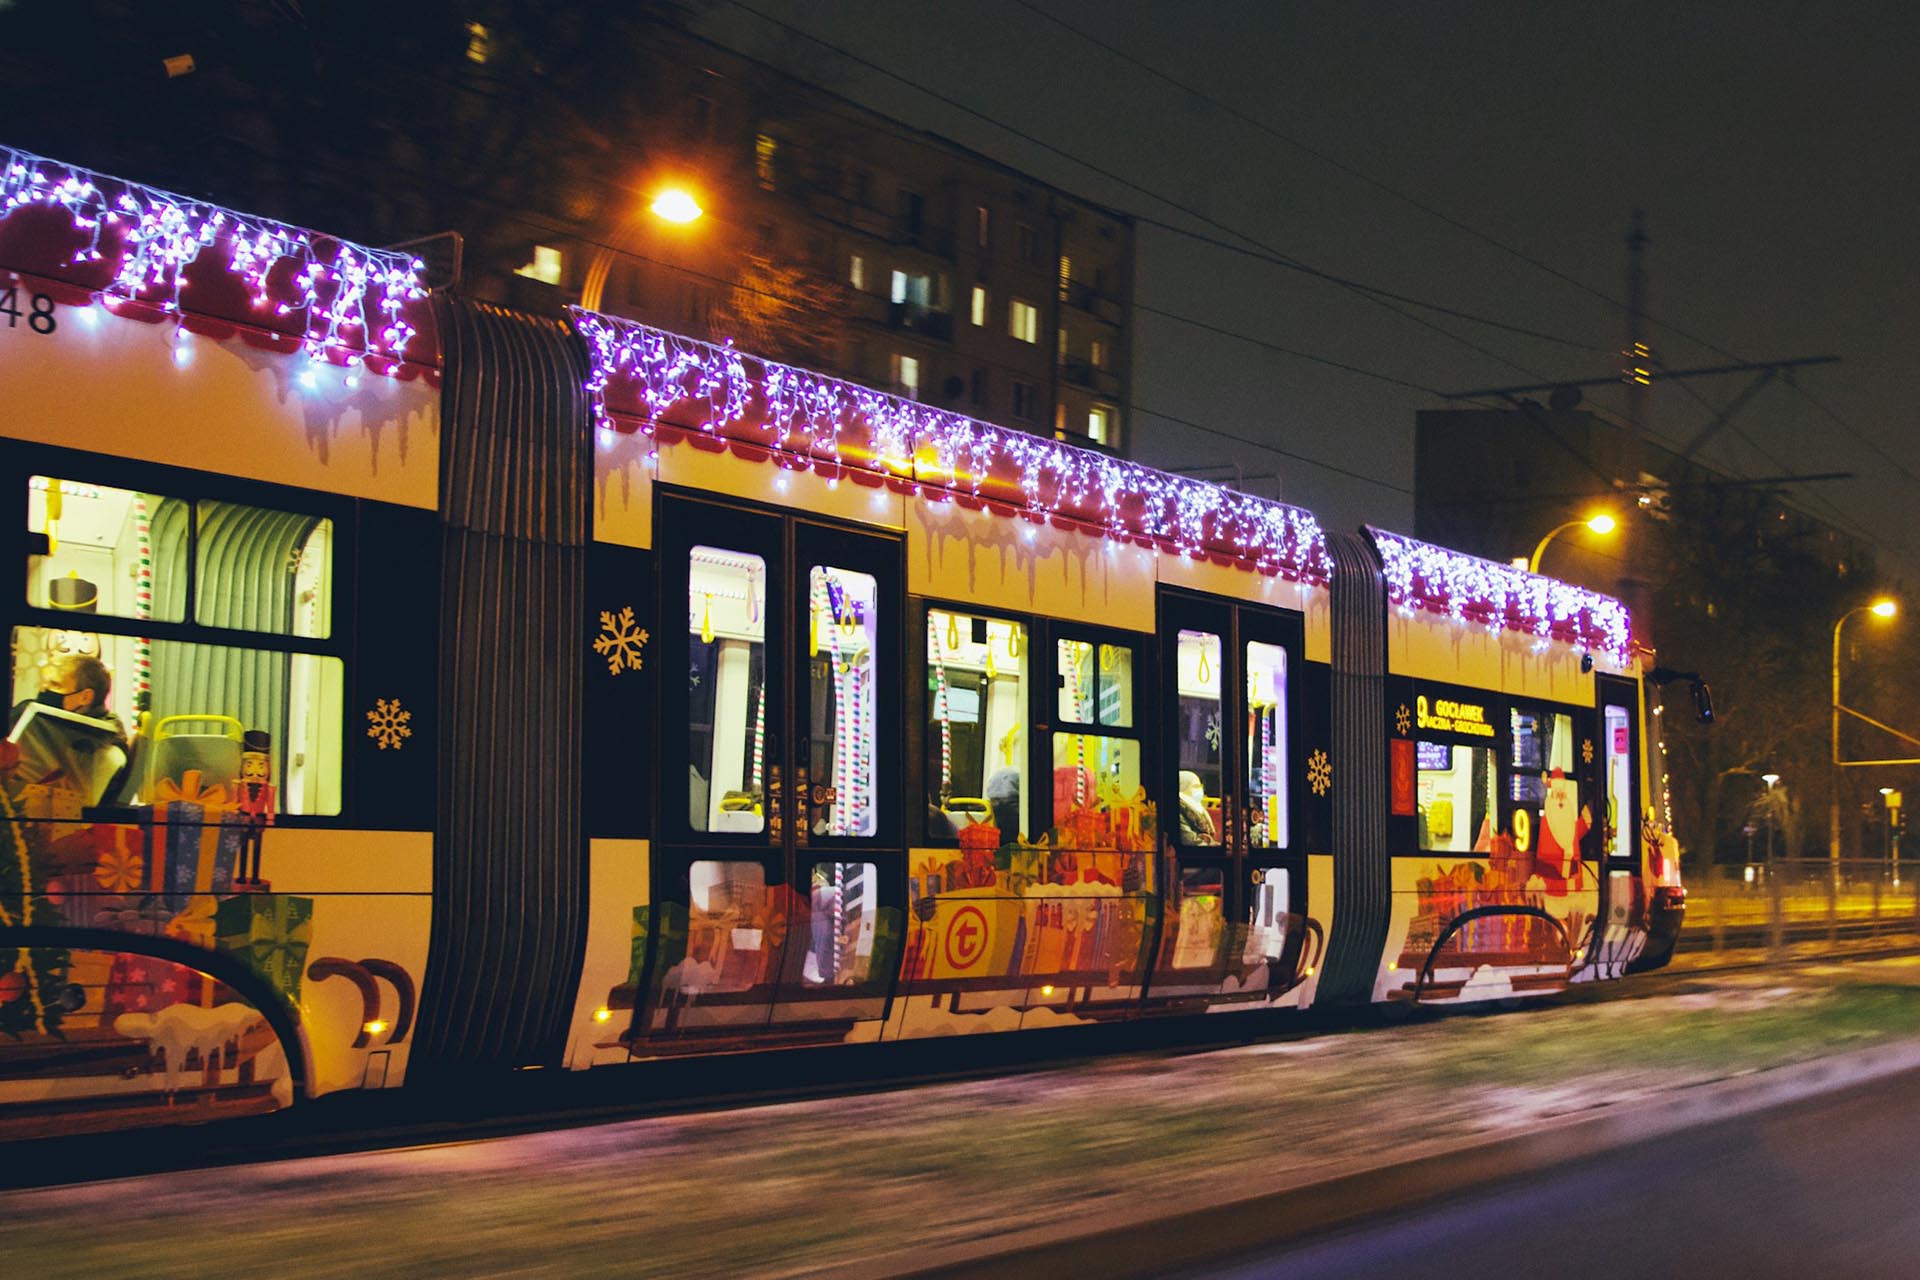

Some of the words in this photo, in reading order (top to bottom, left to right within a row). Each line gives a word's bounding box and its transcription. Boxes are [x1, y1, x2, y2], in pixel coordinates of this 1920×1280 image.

[0, 287, 56, 335] 48
[1417, 695, 1428, 728] 9
[1515, 808, 1530, 852] 9
